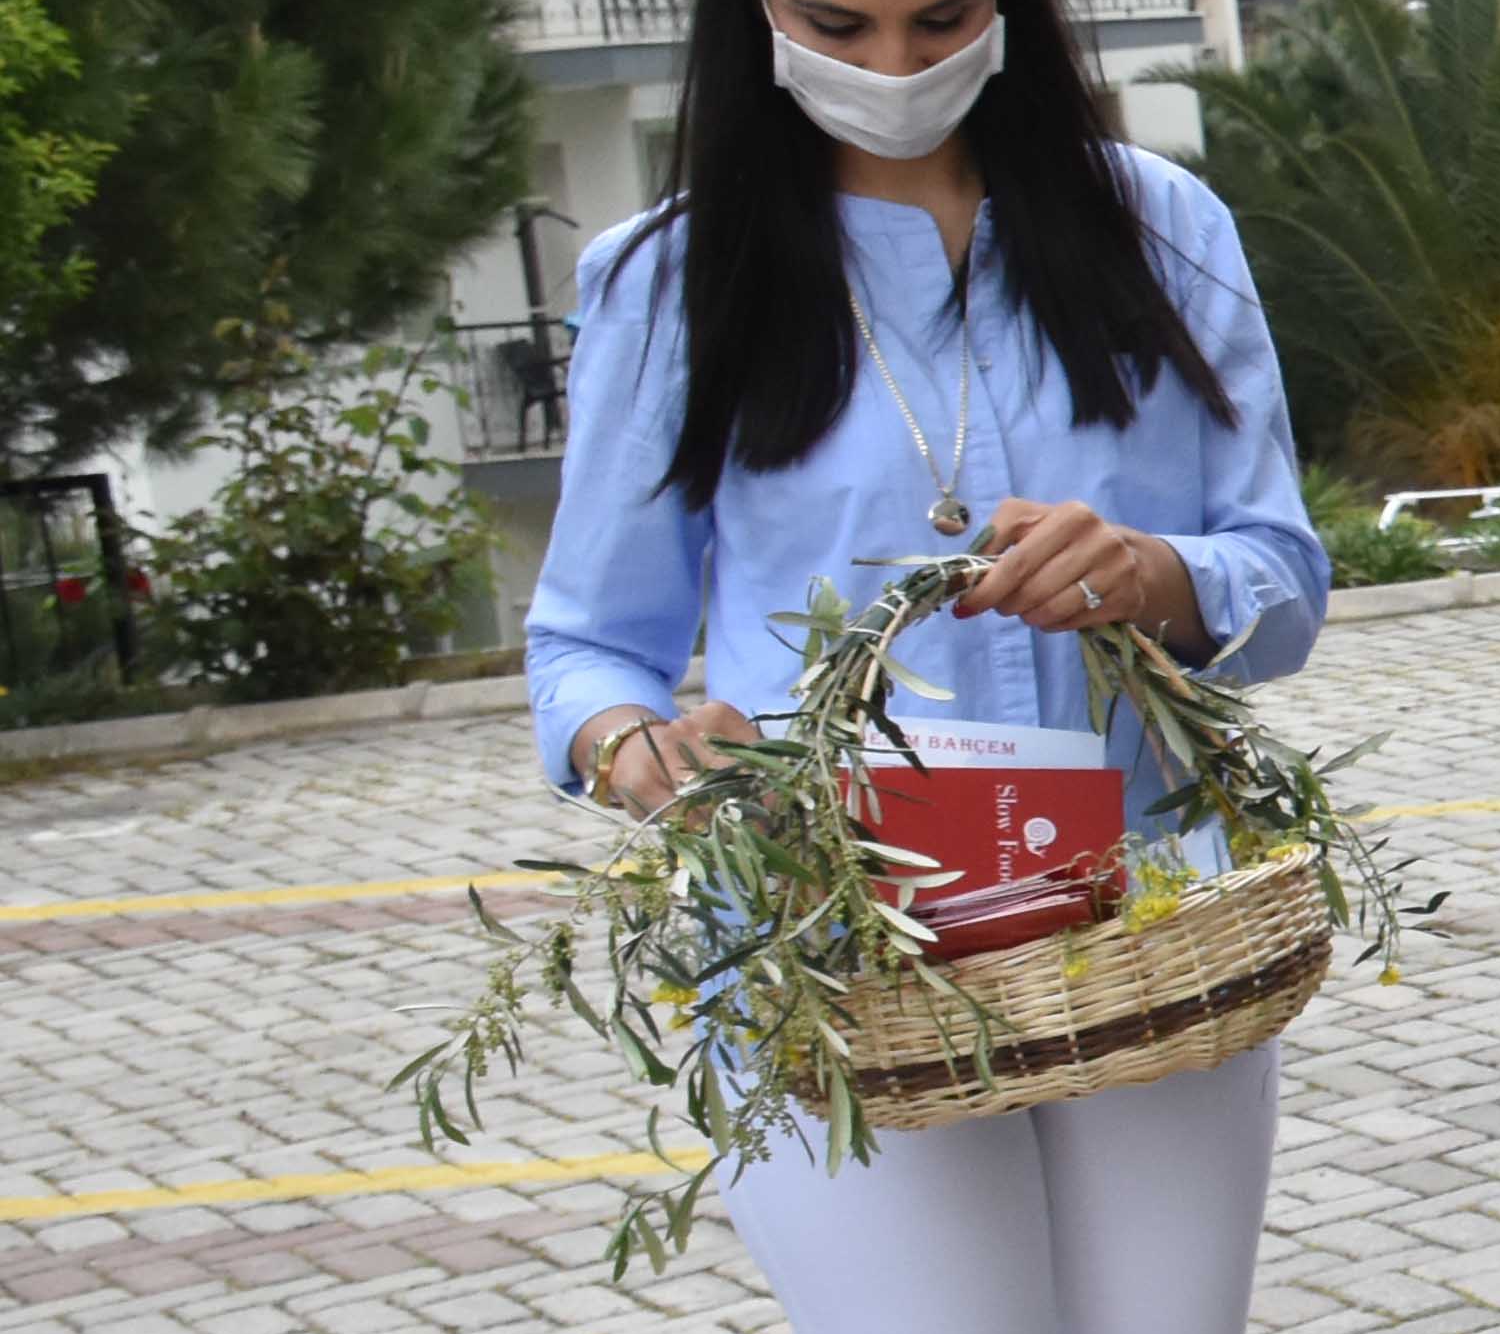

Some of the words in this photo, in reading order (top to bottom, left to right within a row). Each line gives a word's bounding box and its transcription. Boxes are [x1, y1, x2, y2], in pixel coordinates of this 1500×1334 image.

[928, 735, 1016, 756] BAHÇEM
[995, 784, 1018, 832] Slow
[997, 839, 1019, 882] Foo
